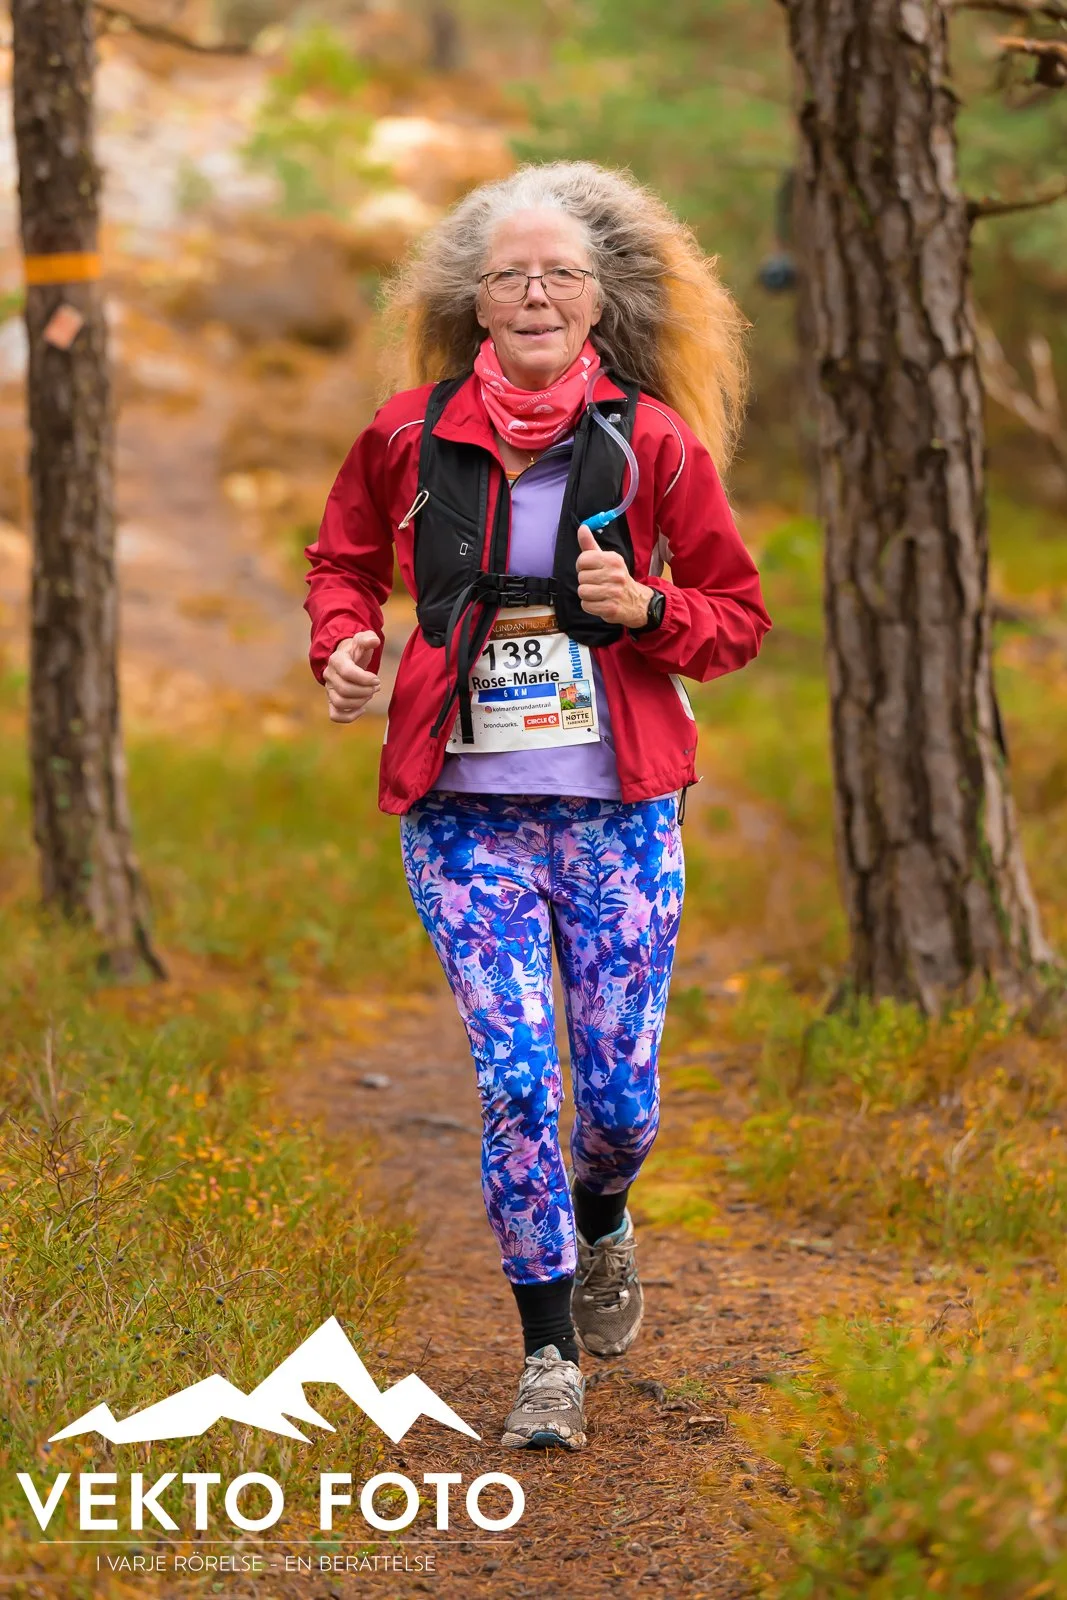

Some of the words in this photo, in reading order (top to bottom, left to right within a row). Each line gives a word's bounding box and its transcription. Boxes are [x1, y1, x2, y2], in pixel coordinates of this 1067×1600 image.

[492, 622, 525, 633] UNDAN
[481, 639, 543, 671] 138
[471, 669, 560, 690] Rose-Marie
[503, 689, 508, 698] 6
[565, 713, 590, 721] NØTTE
